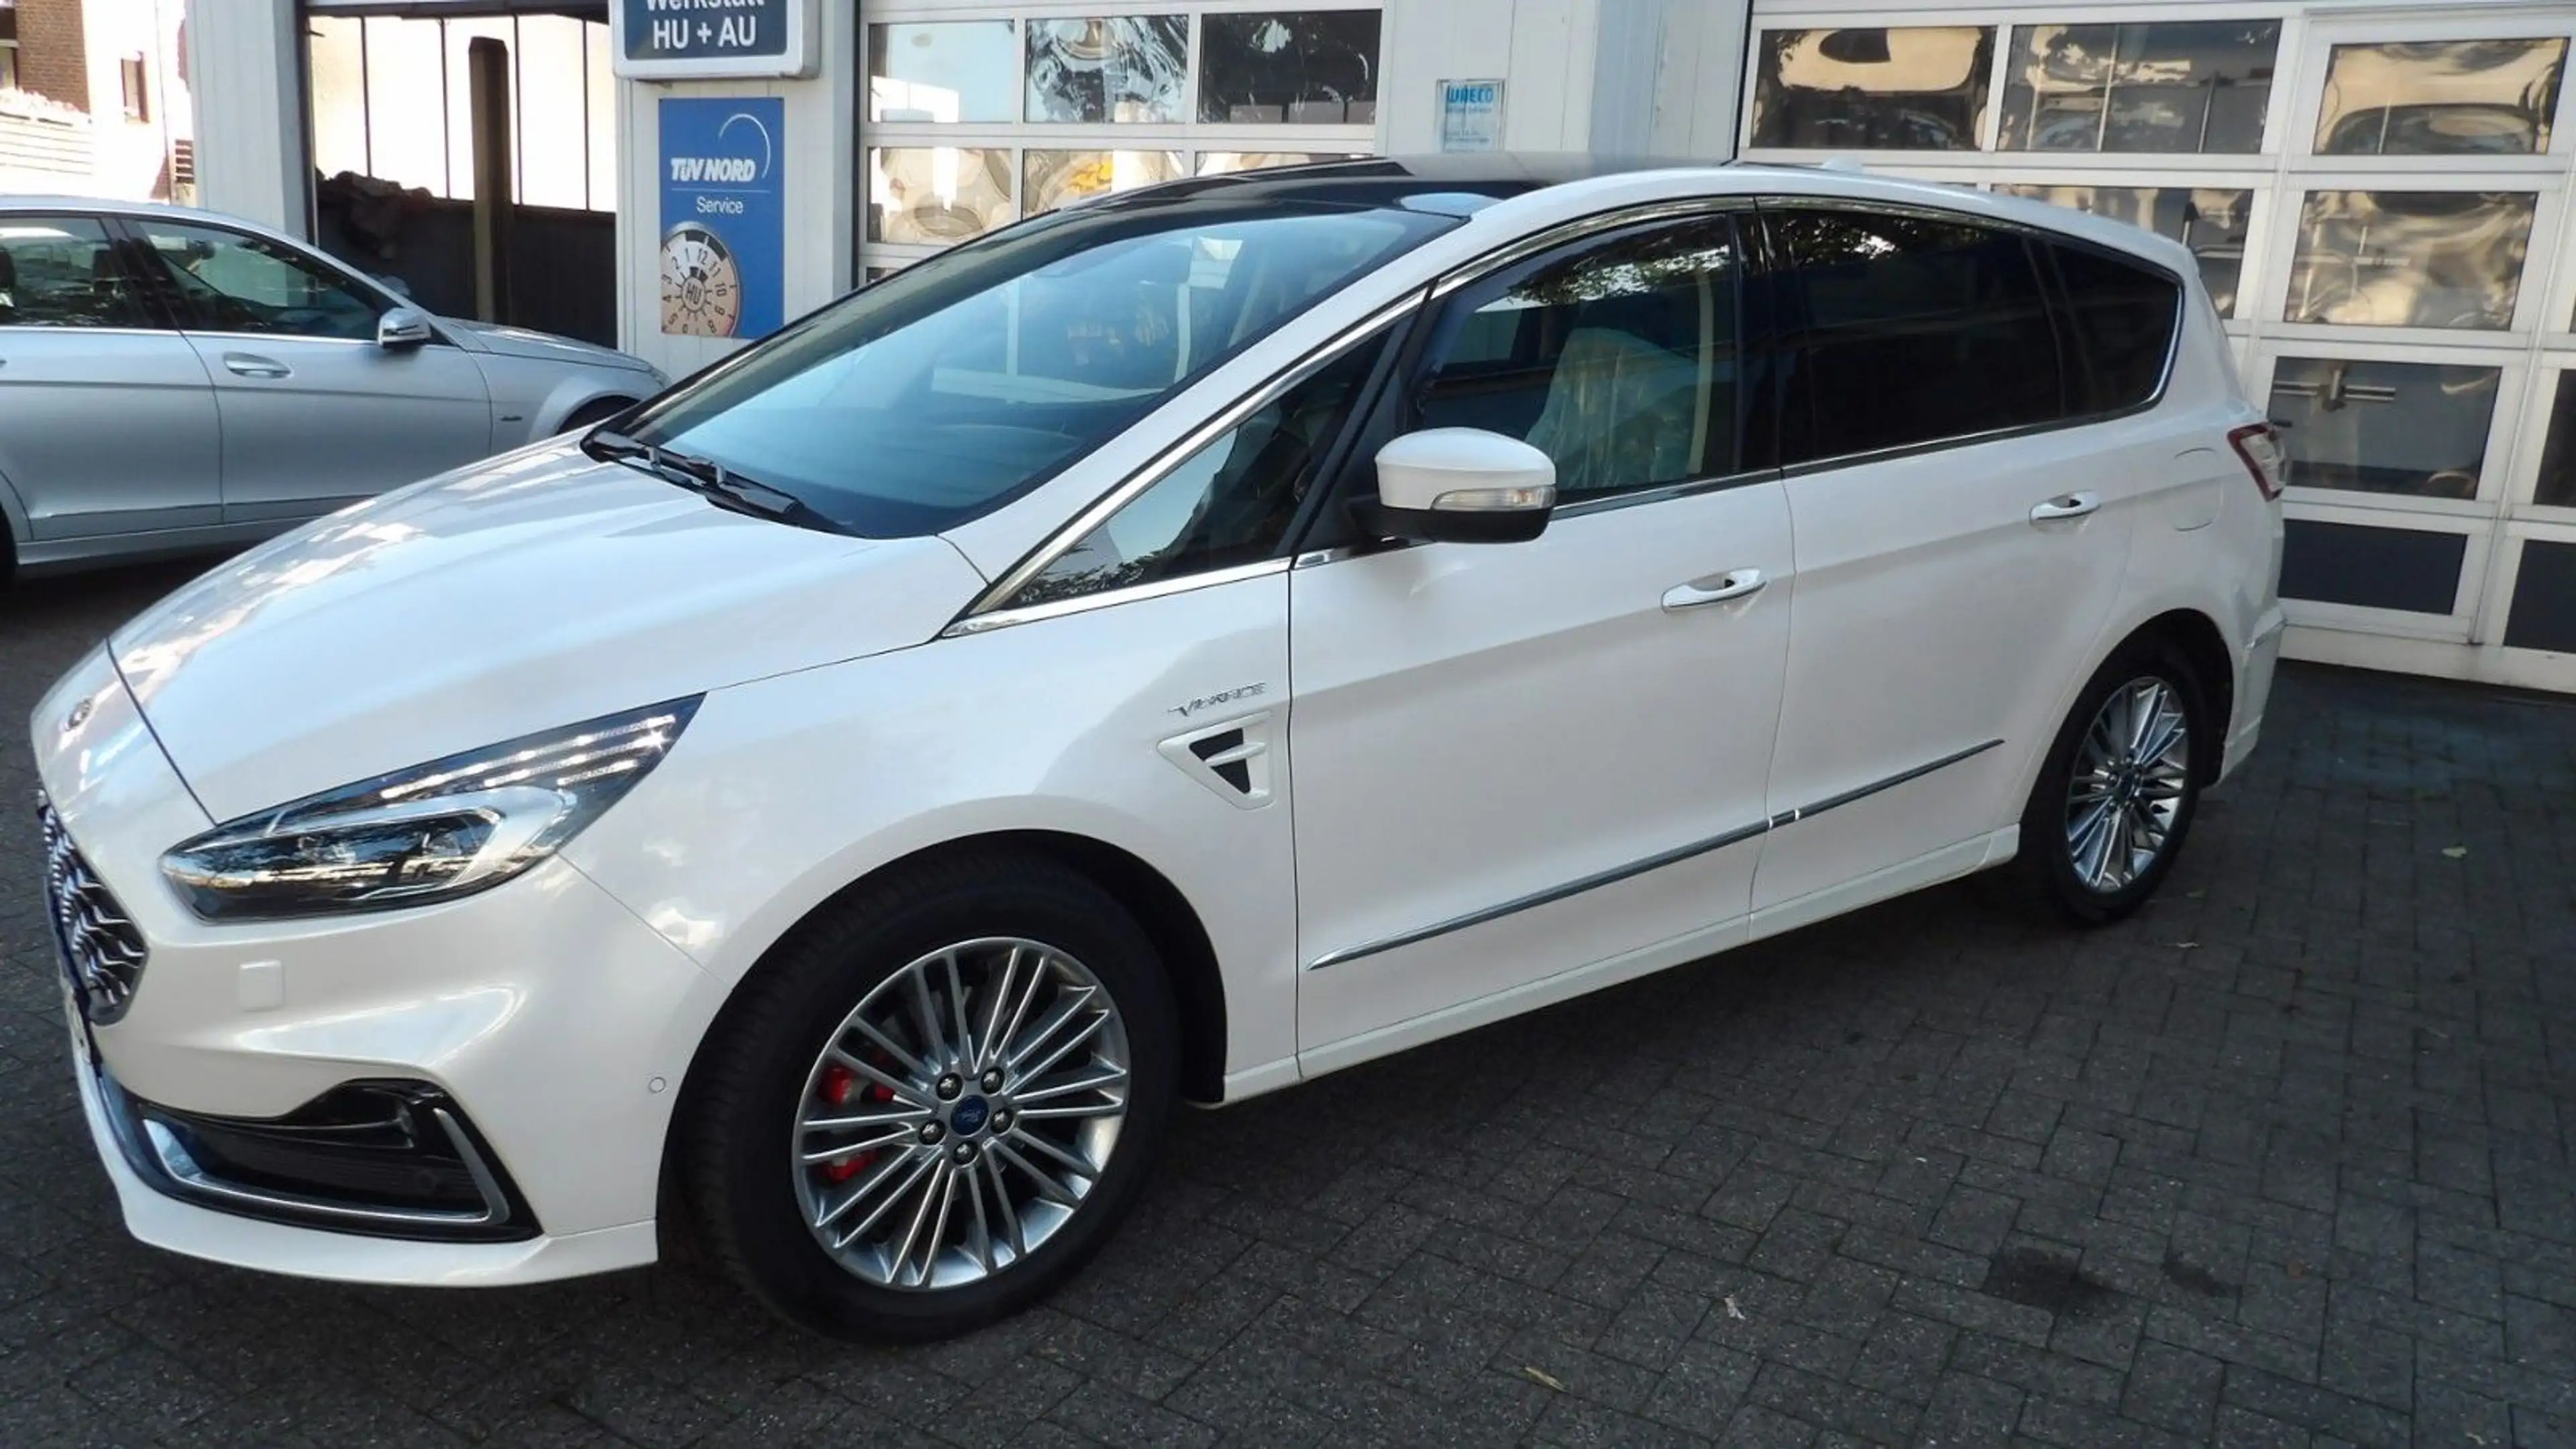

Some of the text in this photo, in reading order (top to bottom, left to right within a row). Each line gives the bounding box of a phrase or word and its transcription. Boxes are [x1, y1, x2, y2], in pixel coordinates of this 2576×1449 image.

[653, 15, 757, 50] HU + AU
[704, 158, 756, 182] NORD
[696, 196, 744, 214] Service
[698, 248, 708, 265] 12
[686, 282, 702, 305] HU
[714, 282, 727, 297] 10
